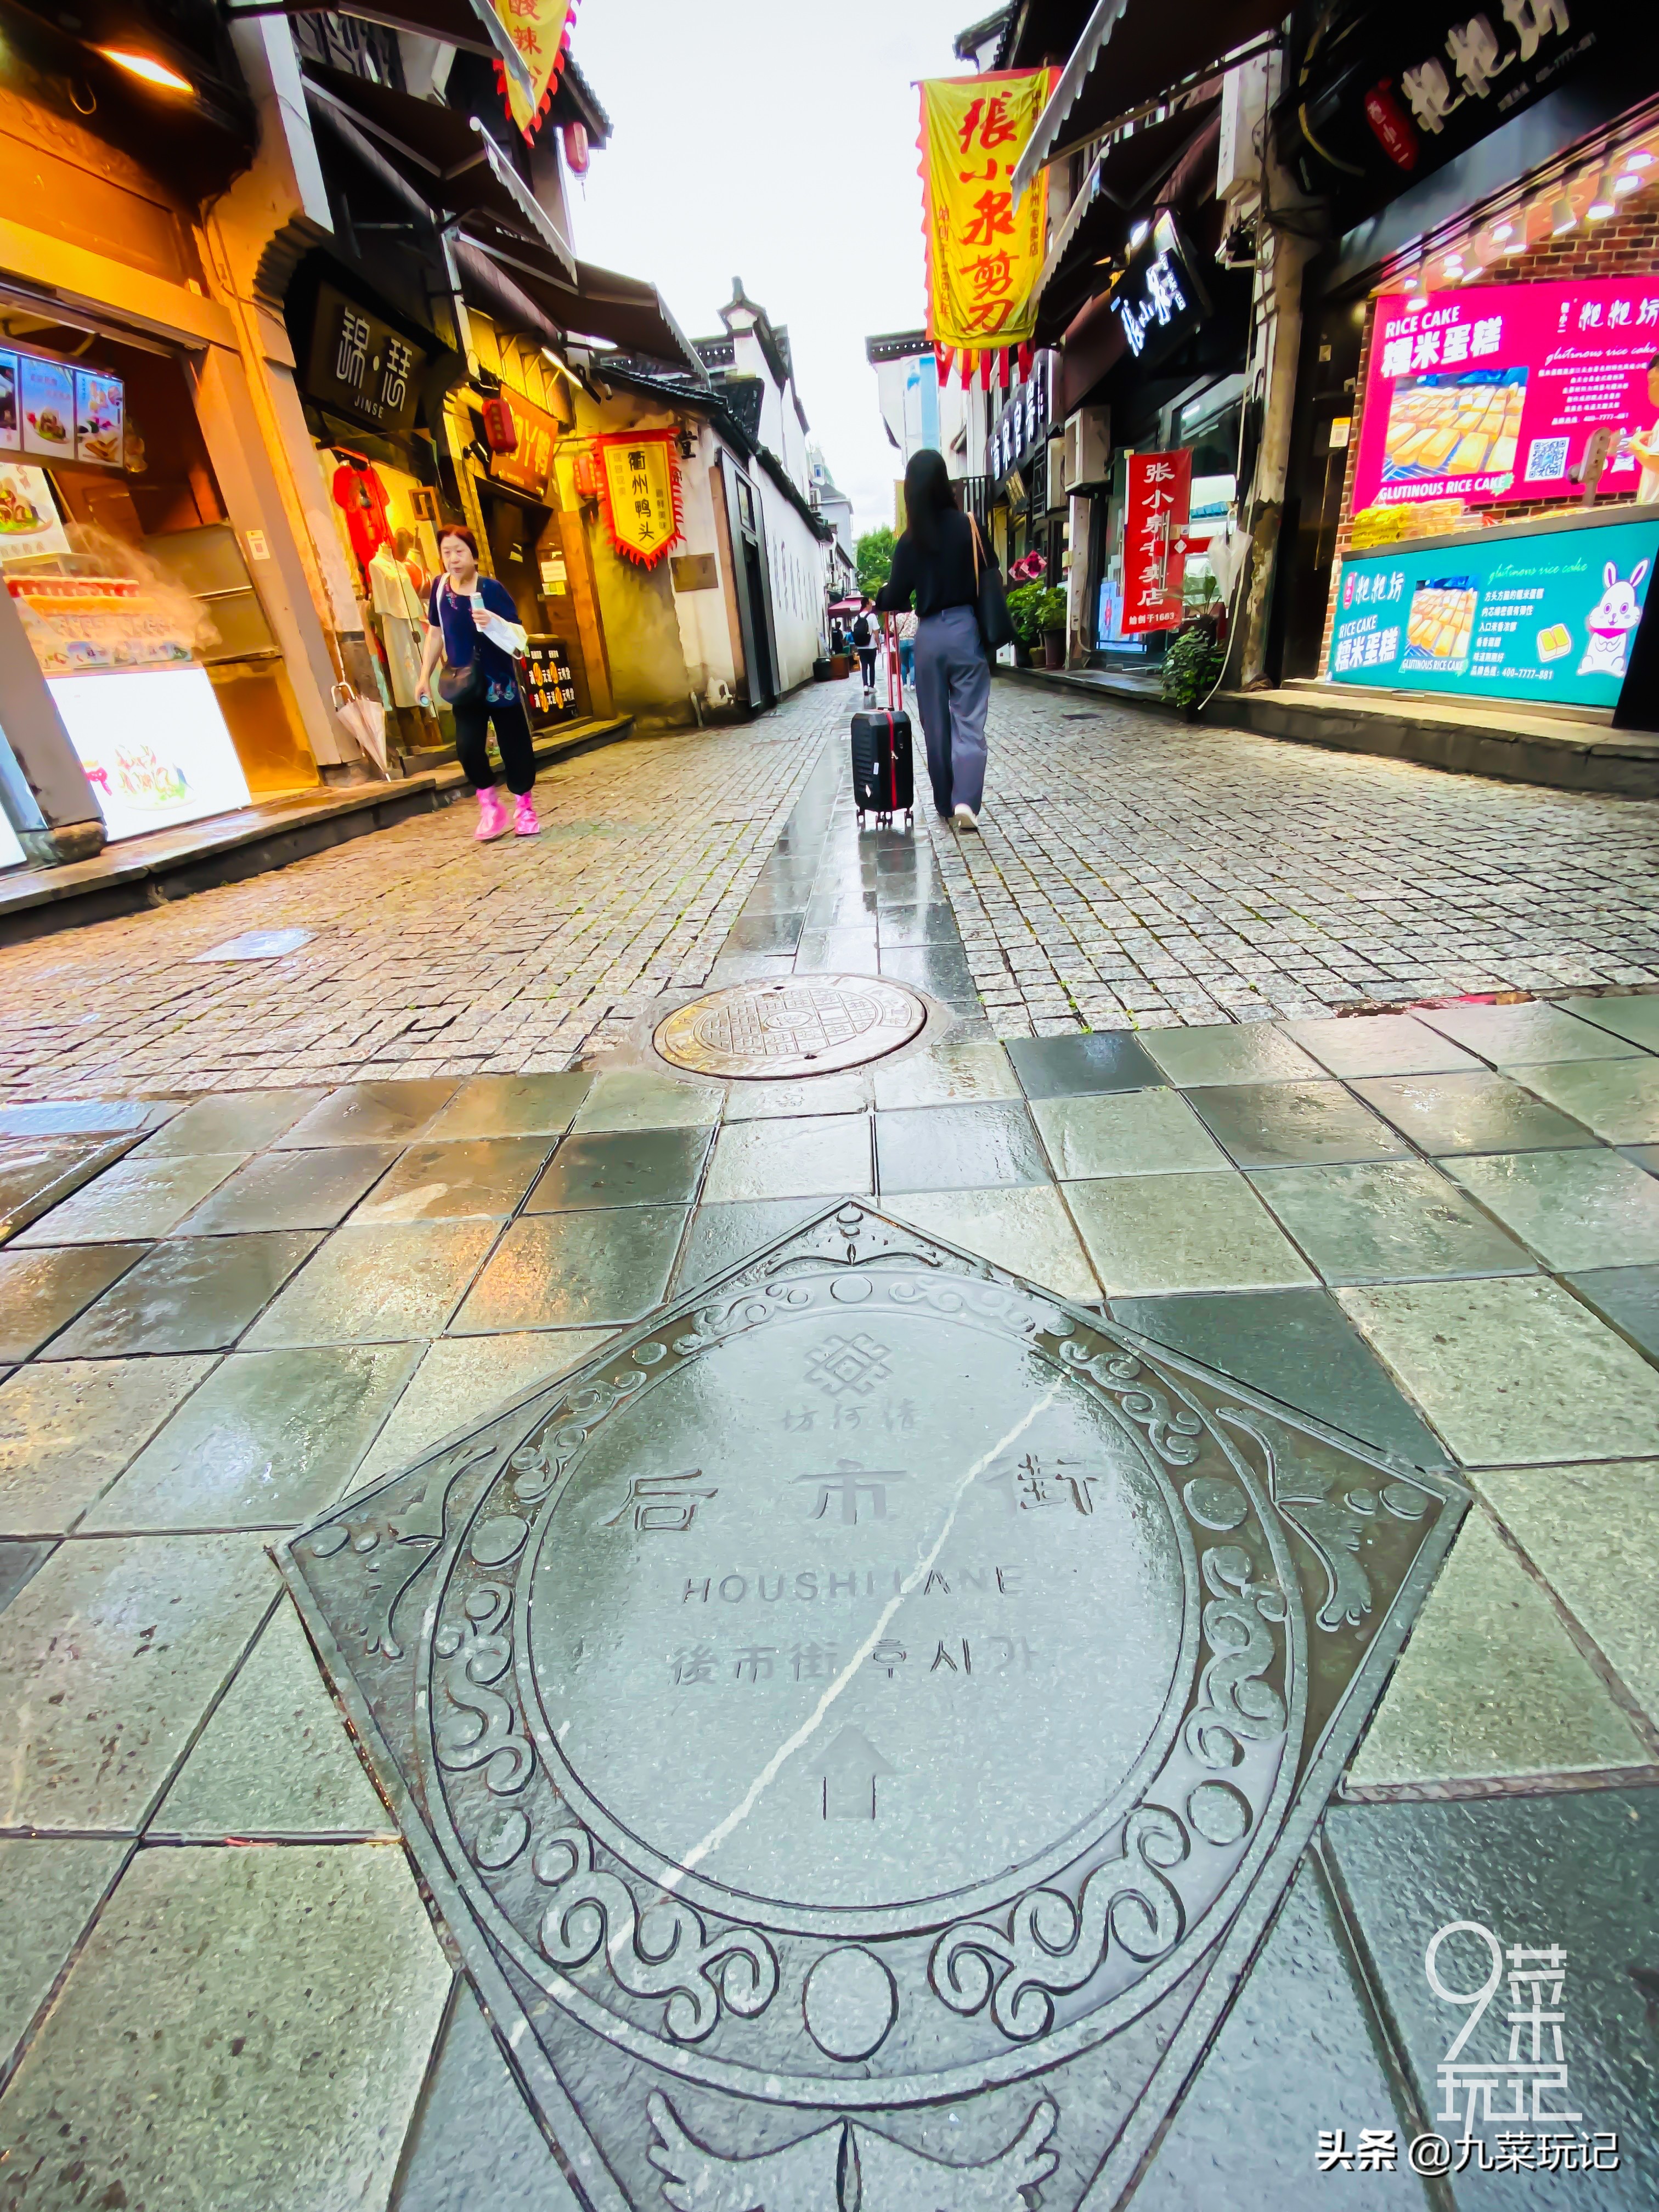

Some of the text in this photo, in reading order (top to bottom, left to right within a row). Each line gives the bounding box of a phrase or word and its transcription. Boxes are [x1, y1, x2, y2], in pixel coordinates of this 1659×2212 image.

[1385, 306, 1460, 338] RICE CAKE
[1380, 315, 1502, 378] 糯米蛋糕
[1605, 346, 1628, 356] rice
[1630, 342, 1657, 354] cake
[354, 394, 383, 419] JINSE
[628, 450, 654, 542] 衢州鸭头
[1379, 475, 1506, 500] GLUTINOUS RICE CAKE
[1539, 562, 1560, 575] rice
[1562, 557, 1588, 573] cake
[1339, 614, 1378, 639] RICE CAKE
[1334, 627, 1398, 672] 糯米蛋糕
[1402, 659, 1464, 671] GLUTINOUS RICE CAKE
[1502, 668, 1554, 680] 400-7777-881
[599, 1452, 1098, 1531] 后市街
[683, 1566, 1022, 1603] HOUSHI LANE
[873, 1637, 1038, 1679] 후시가
